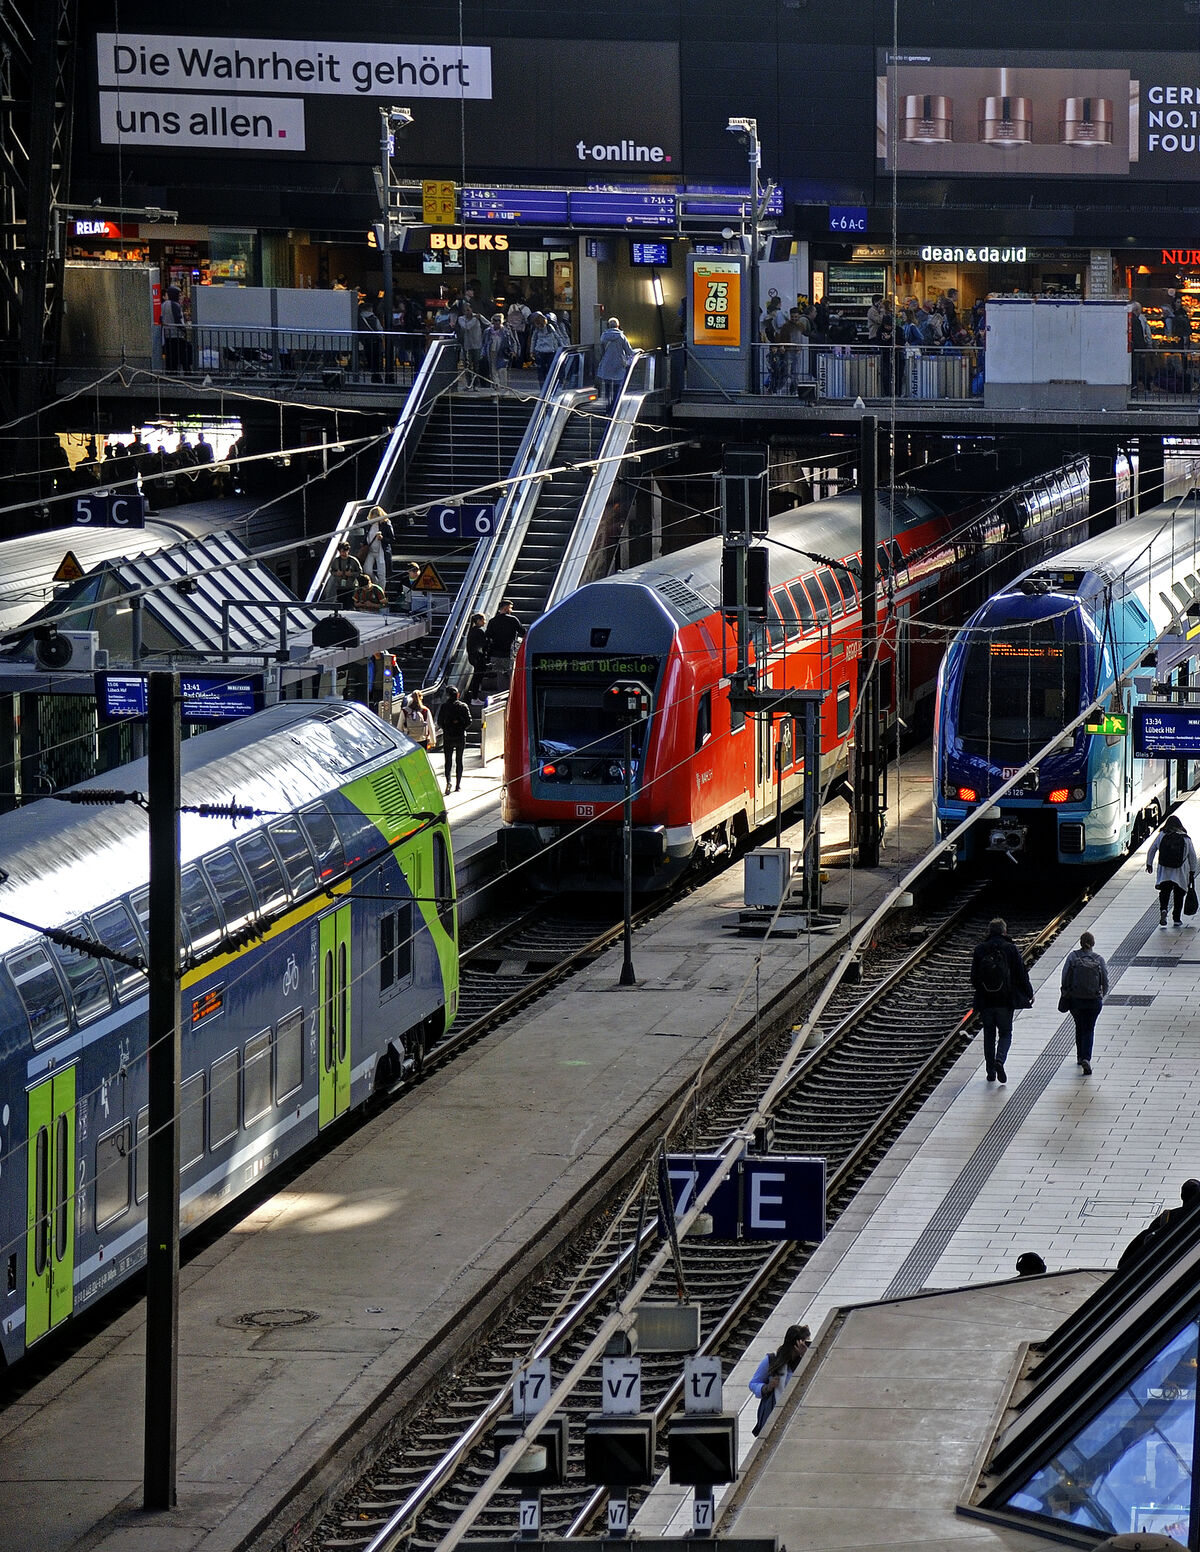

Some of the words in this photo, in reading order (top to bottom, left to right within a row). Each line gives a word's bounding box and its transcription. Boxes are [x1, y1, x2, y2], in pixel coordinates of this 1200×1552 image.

[113, 45, 170, 76] Die
[177, 47, 341, 82] Wahrheit
[352, 56, 470, 92] gehört
[115, 109, 180, 134] uns
[188, 106, 287, 138] allen.
[651, 196, 666, 204] 7-14
[76, 221, 106, 235] RELAY
[840, 216, 847, 229] 6
[849, 219, 865, 230] A-C
[707, 282, 728, 298] 75
[704, 297, 728, 313] GB
[76, 499, 92, 524] 5
[111, 500, 130, 525] C
[438, 508, 457, 534] C
[475, 507, 492, 534] 6
[599, 659, 655, 673] Oldesloe
[183, 683, 200, 691] 13:41
[1145, 726, 1165, 734] Lübeck
[1165, 726, 1176, 734] Hbf
[577, 805, 592, 816] DB
[667, 1170, 700, 1220] 7
[750, 1172, 787, 1229] E
[519, 1373, 546, 1399] r7
[607, 1373, 639, 1399] v7
[691, 1372, 717, 1398] t7
[521, 1505, 536, 1526] r7
[609, 1504, 626, 1525] v7
[695, 1503, 710, 1525] t7
